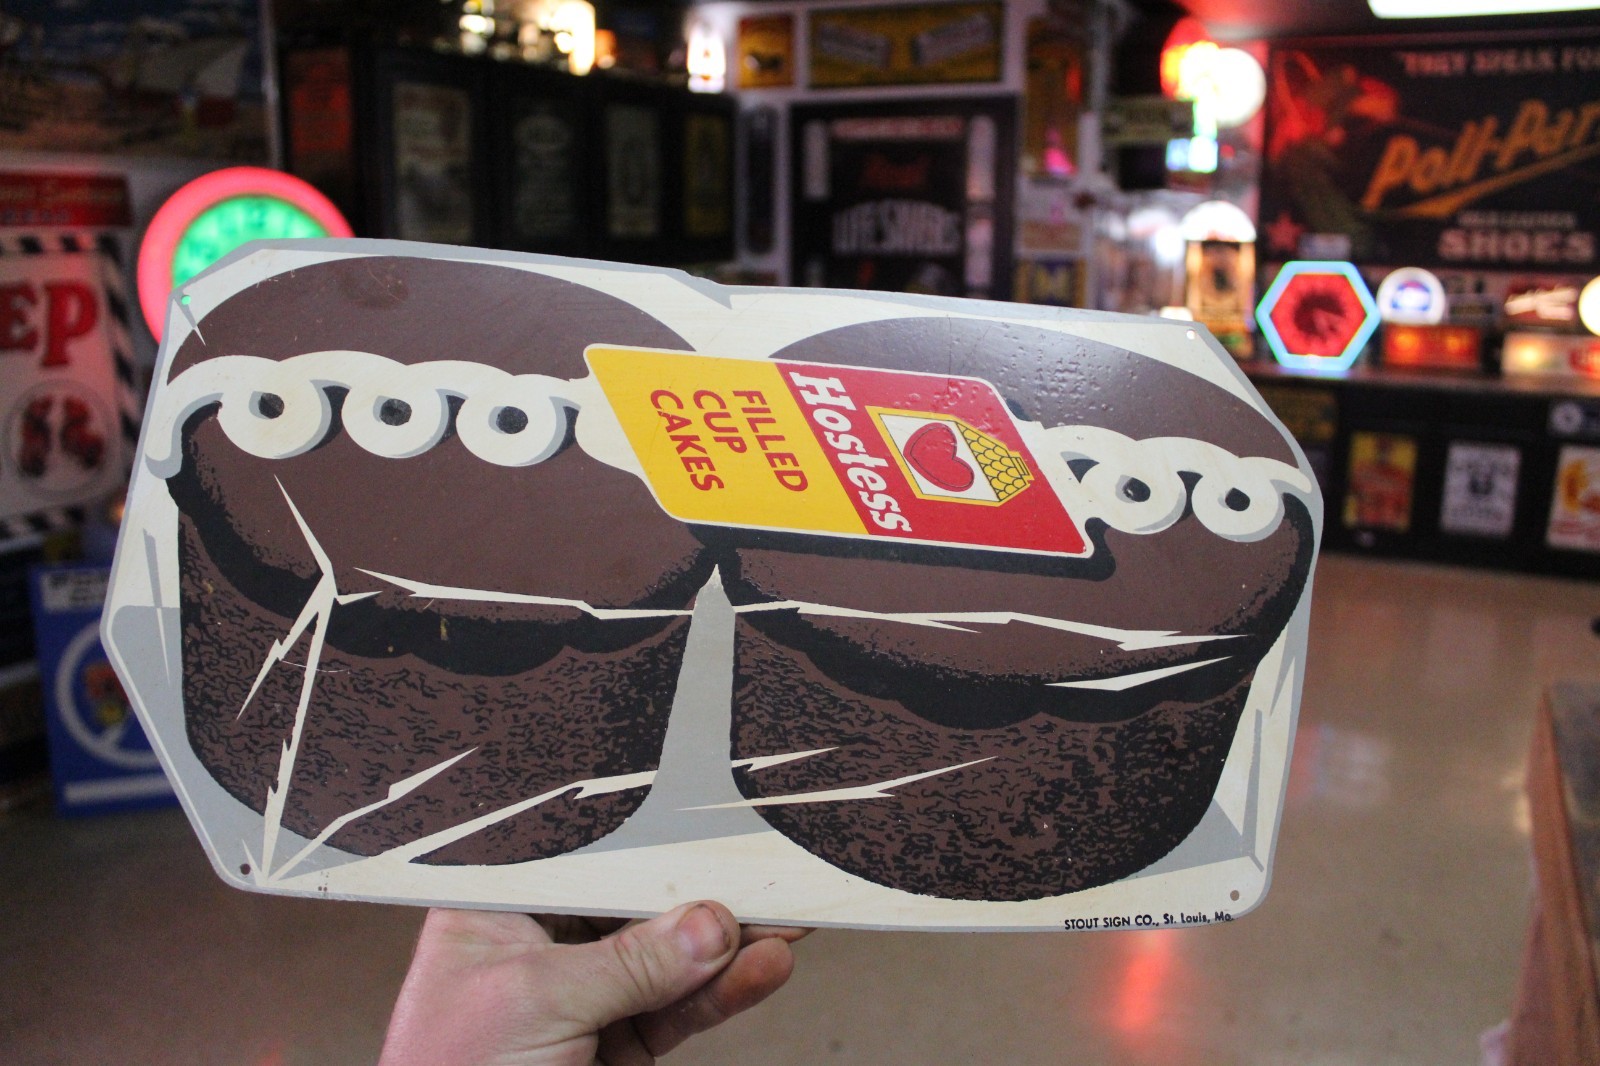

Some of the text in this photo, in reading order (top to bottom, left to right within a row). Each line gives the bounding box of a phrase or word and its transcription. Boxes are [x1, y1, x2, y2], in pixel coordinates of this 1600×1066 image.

[1437, 228, 1595, 264] SHOES
[649, 388, 725, 493] CAKES
[692, 389, 748, 455] CUP
[732, 389, 809, 493] FILLED
[788, 371, 912, 533] Hostess
[1064, 917, 1099, 931] STOUT
[1103, 916, 1131, 928] SIGN
[1163, 913, 1177, 925] St.
